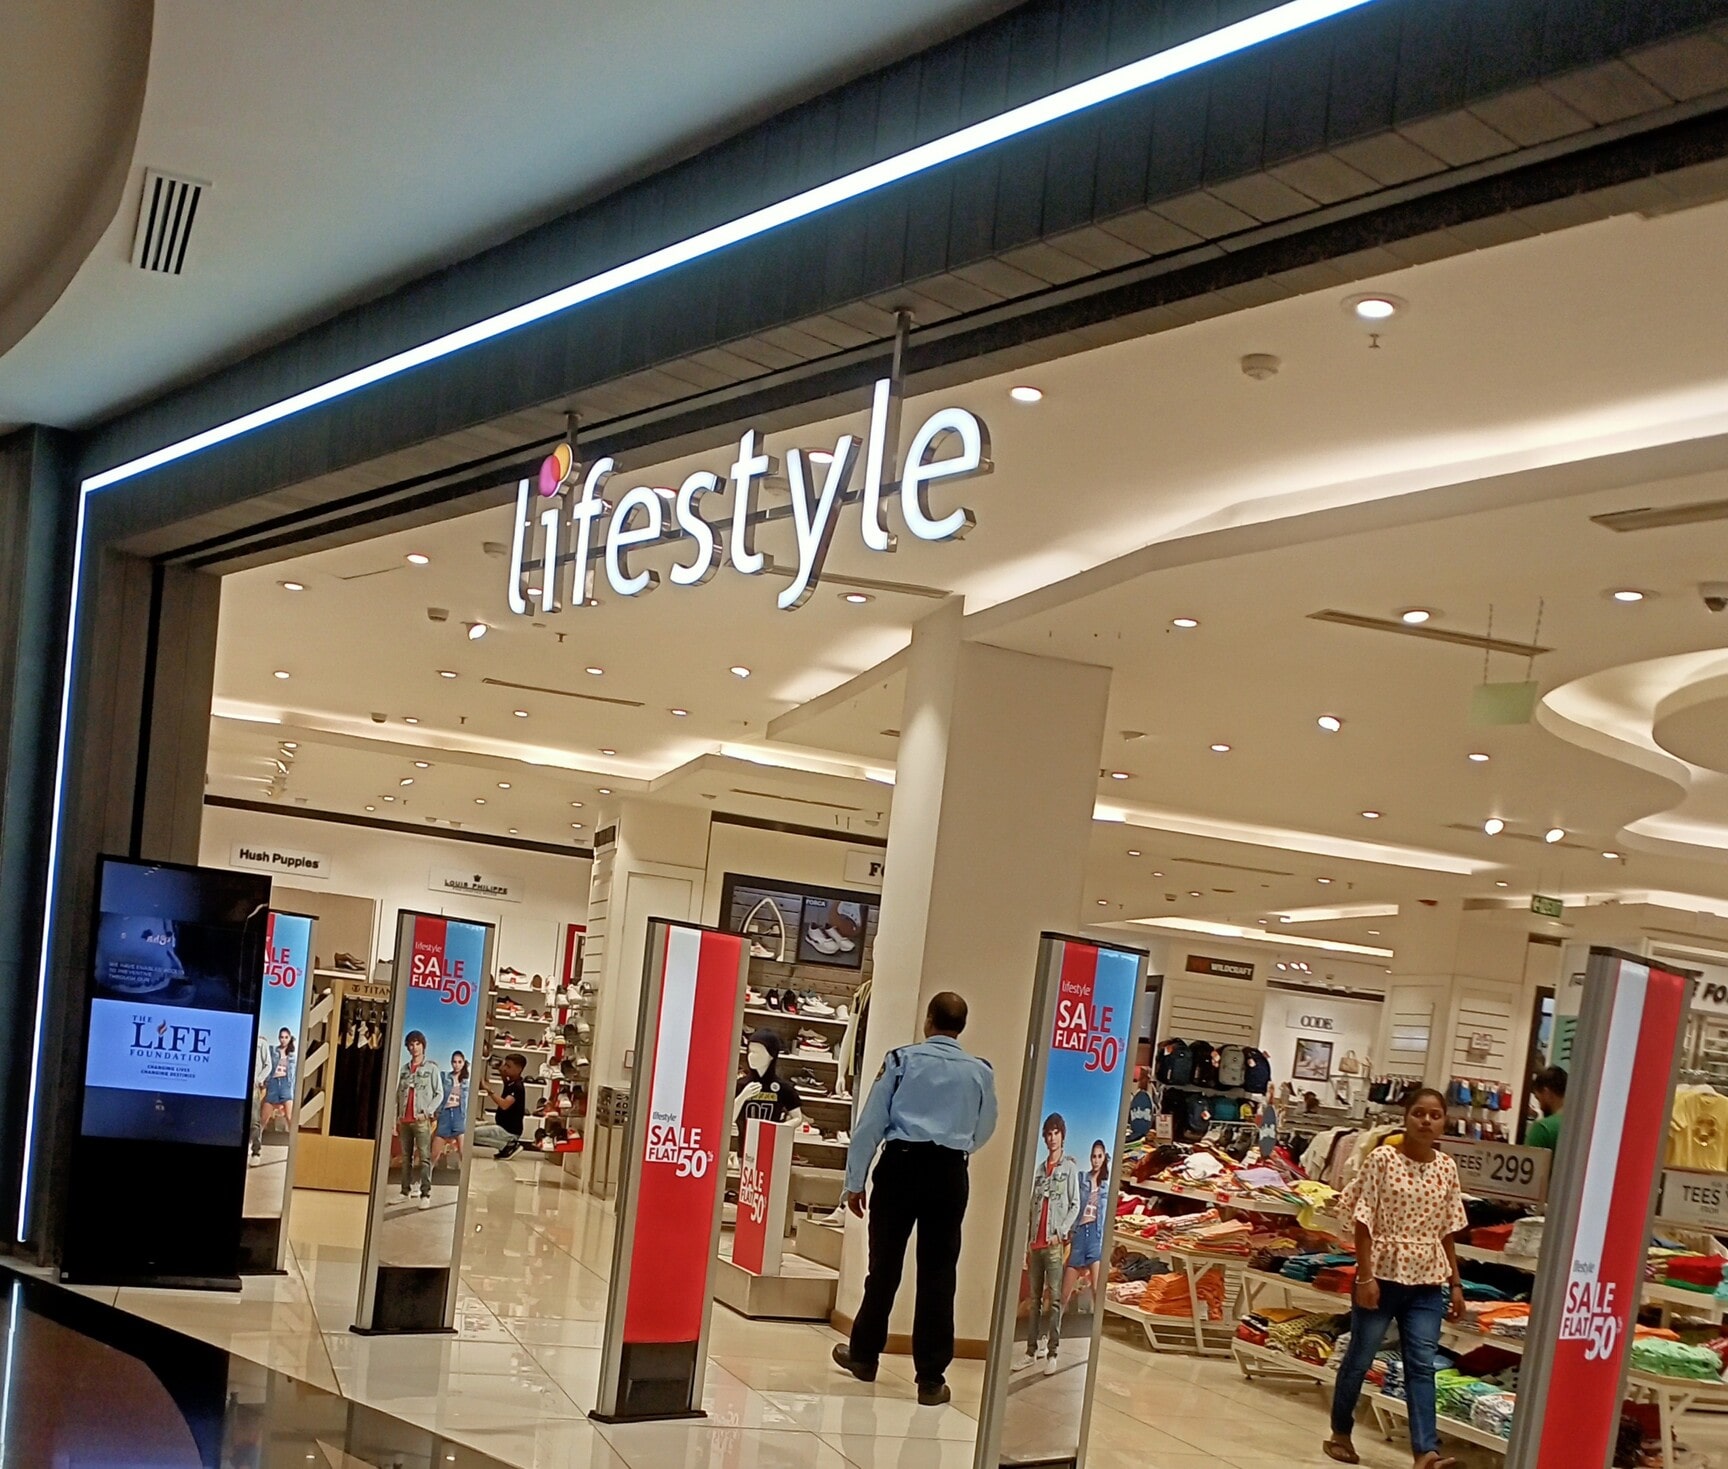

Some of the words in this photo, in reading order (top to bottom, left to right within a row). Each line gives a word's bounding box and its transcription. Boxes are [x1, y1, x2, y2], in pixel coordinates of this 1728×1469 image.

[508, 378, 990, 614] lifestyle
[239, 848, 270, 863] Hush
[272, 852, 320, 869] Puppies
[444, 879, 468, 889] LOUIS
[472, 883, 508, 894] PHILIPPE
[415, 941, 442, 953] lifestyle
[413, 954, 465, 979] SALE
[1210, 962, 1253, 976] WILDCRAFT
[412, 974, 441, 989] FLAT
[1061, 980, 1091, 997] lifestyle
[1702, 982, 1728, 1005] FO
[132, 1014, 152, 1023] THE
[1058, 1000, 1114, 1034] SALE
[1300, 1015, 1334, 1030] CODE
[1055, 1030, 1087, 1050] FLAT
[129, 1049, 210, 1063] FOUNDATION
[652, 1111, 677, 1123] lifestyle
[650, 1125, 702, 1149] SALE
[648, 1147, 678, 1161] FLAT
[742, 1166, 764, 1193] SALE
[1683, 1185, 1721, 1206] TEES
[1566, 1281, 1616, 1314] SALE
[1562, 1317, 1589, 1337] FLAT
